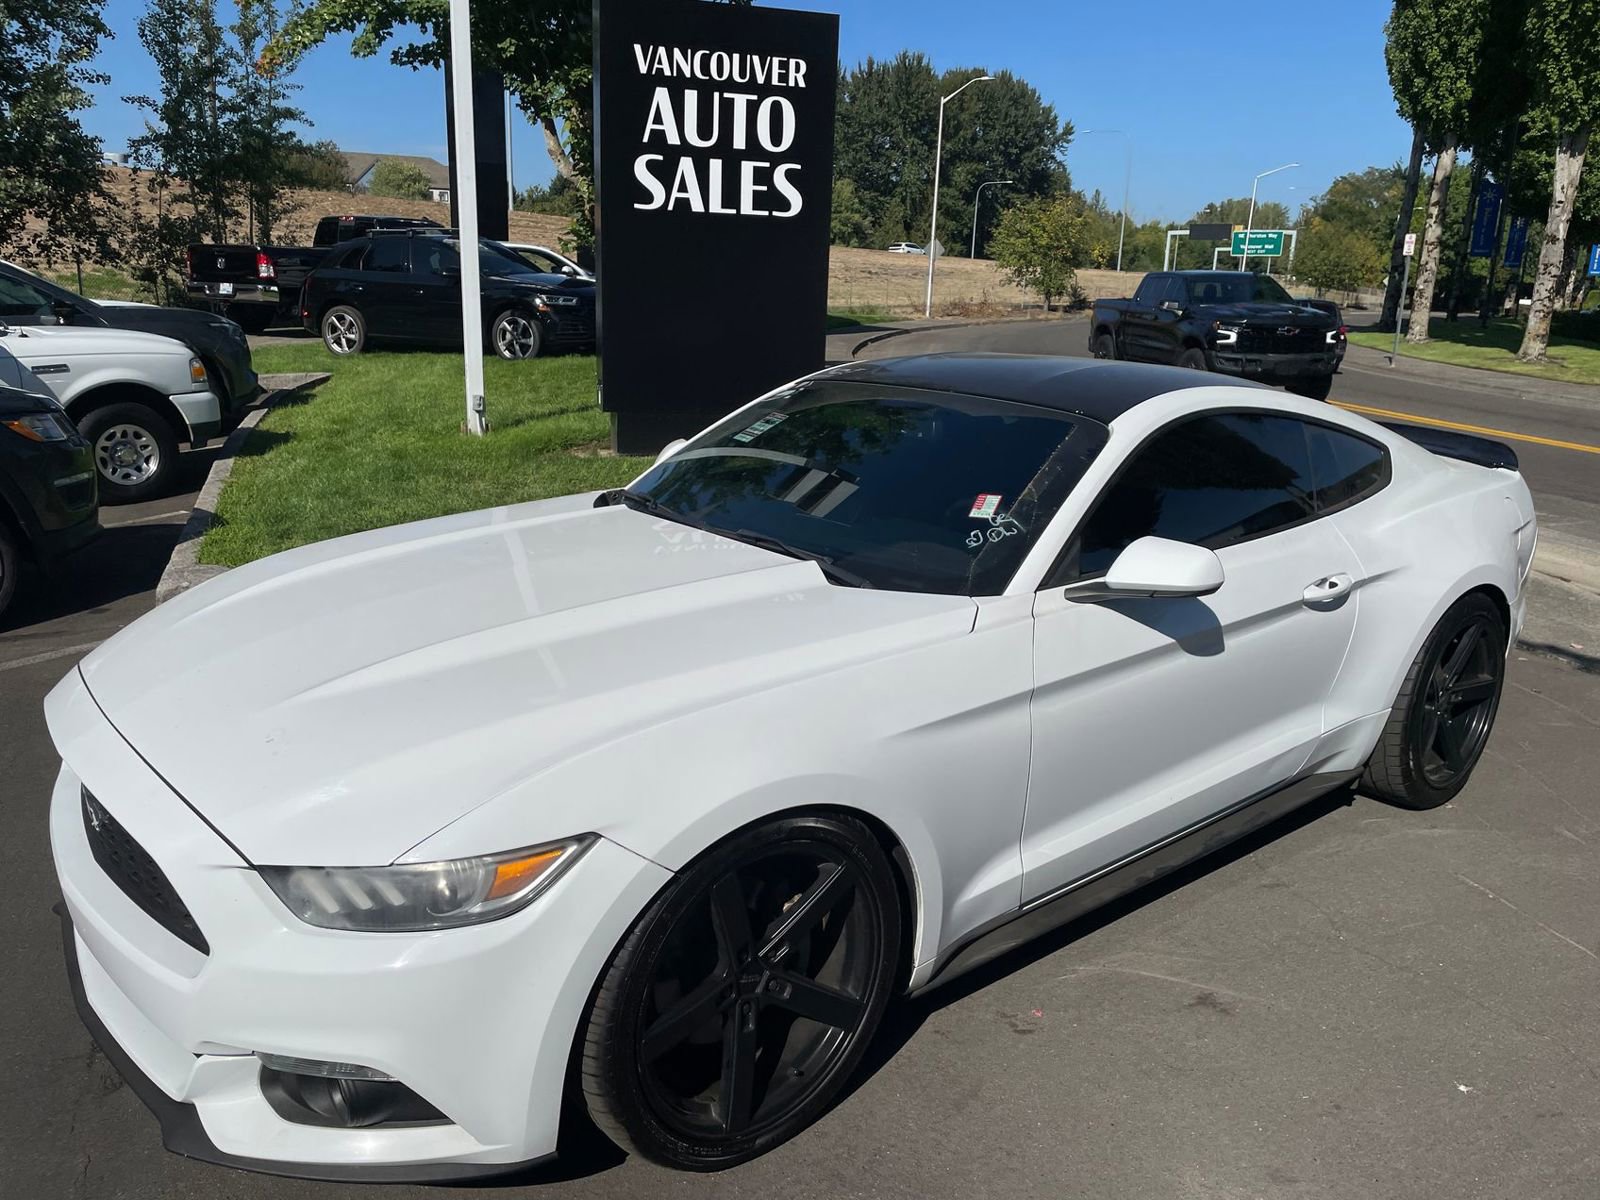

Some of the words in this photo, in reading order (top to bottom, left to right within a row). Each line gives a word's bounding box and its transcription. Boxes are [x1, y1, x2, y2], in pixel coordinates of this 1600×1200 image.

[634, 44, 807, 88] VANCOUVER
[642, 87, 796, 153] AUTO
[633, 154, 803, 218] SALES
